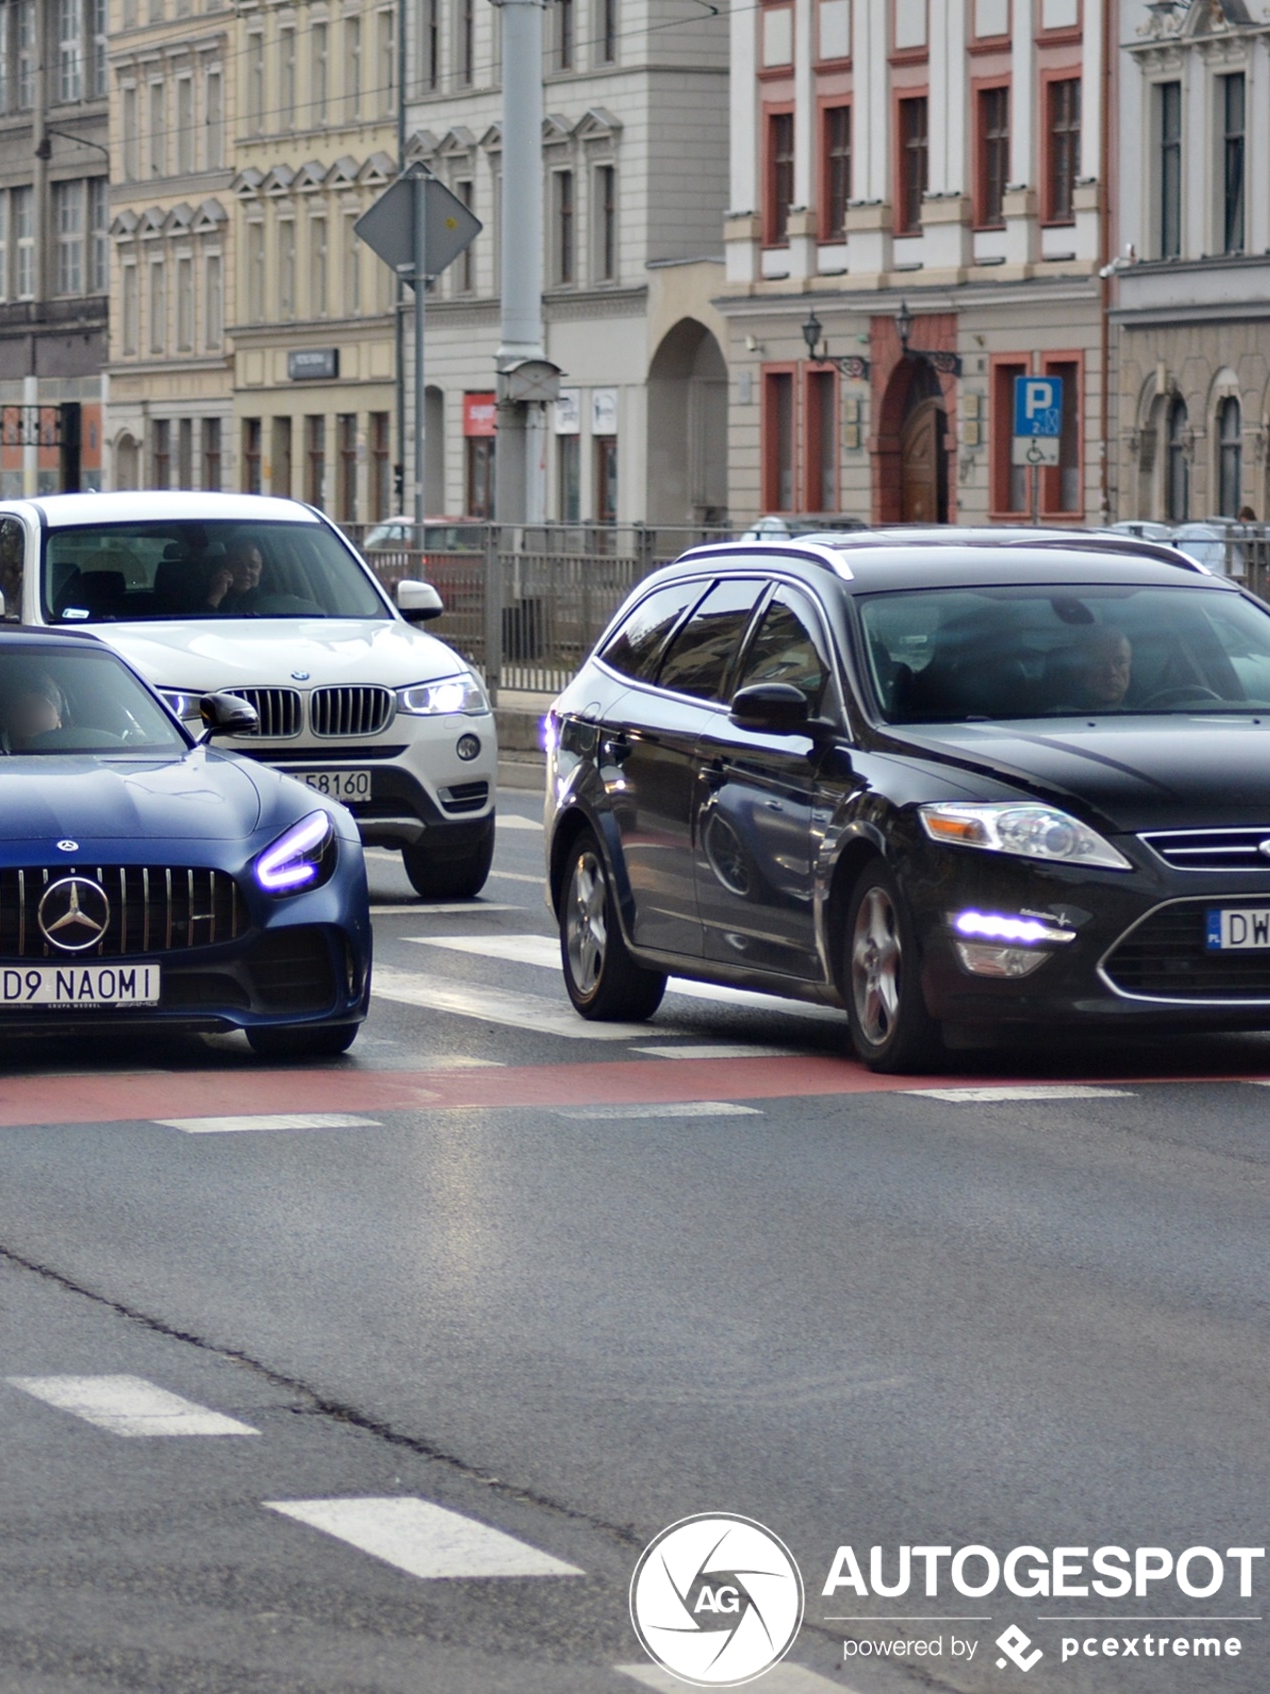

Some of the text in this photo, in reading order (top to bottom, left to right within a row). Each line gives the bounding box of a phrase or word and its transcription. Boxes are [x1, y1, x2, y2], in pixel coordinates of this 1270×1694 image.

[1026, 382, 1052, 419] P
[1208, 934, 1221, 943] PL
[1229, 913, 1270, 945] DW
[3, 968, 149, 1000] D9 NAOMI
